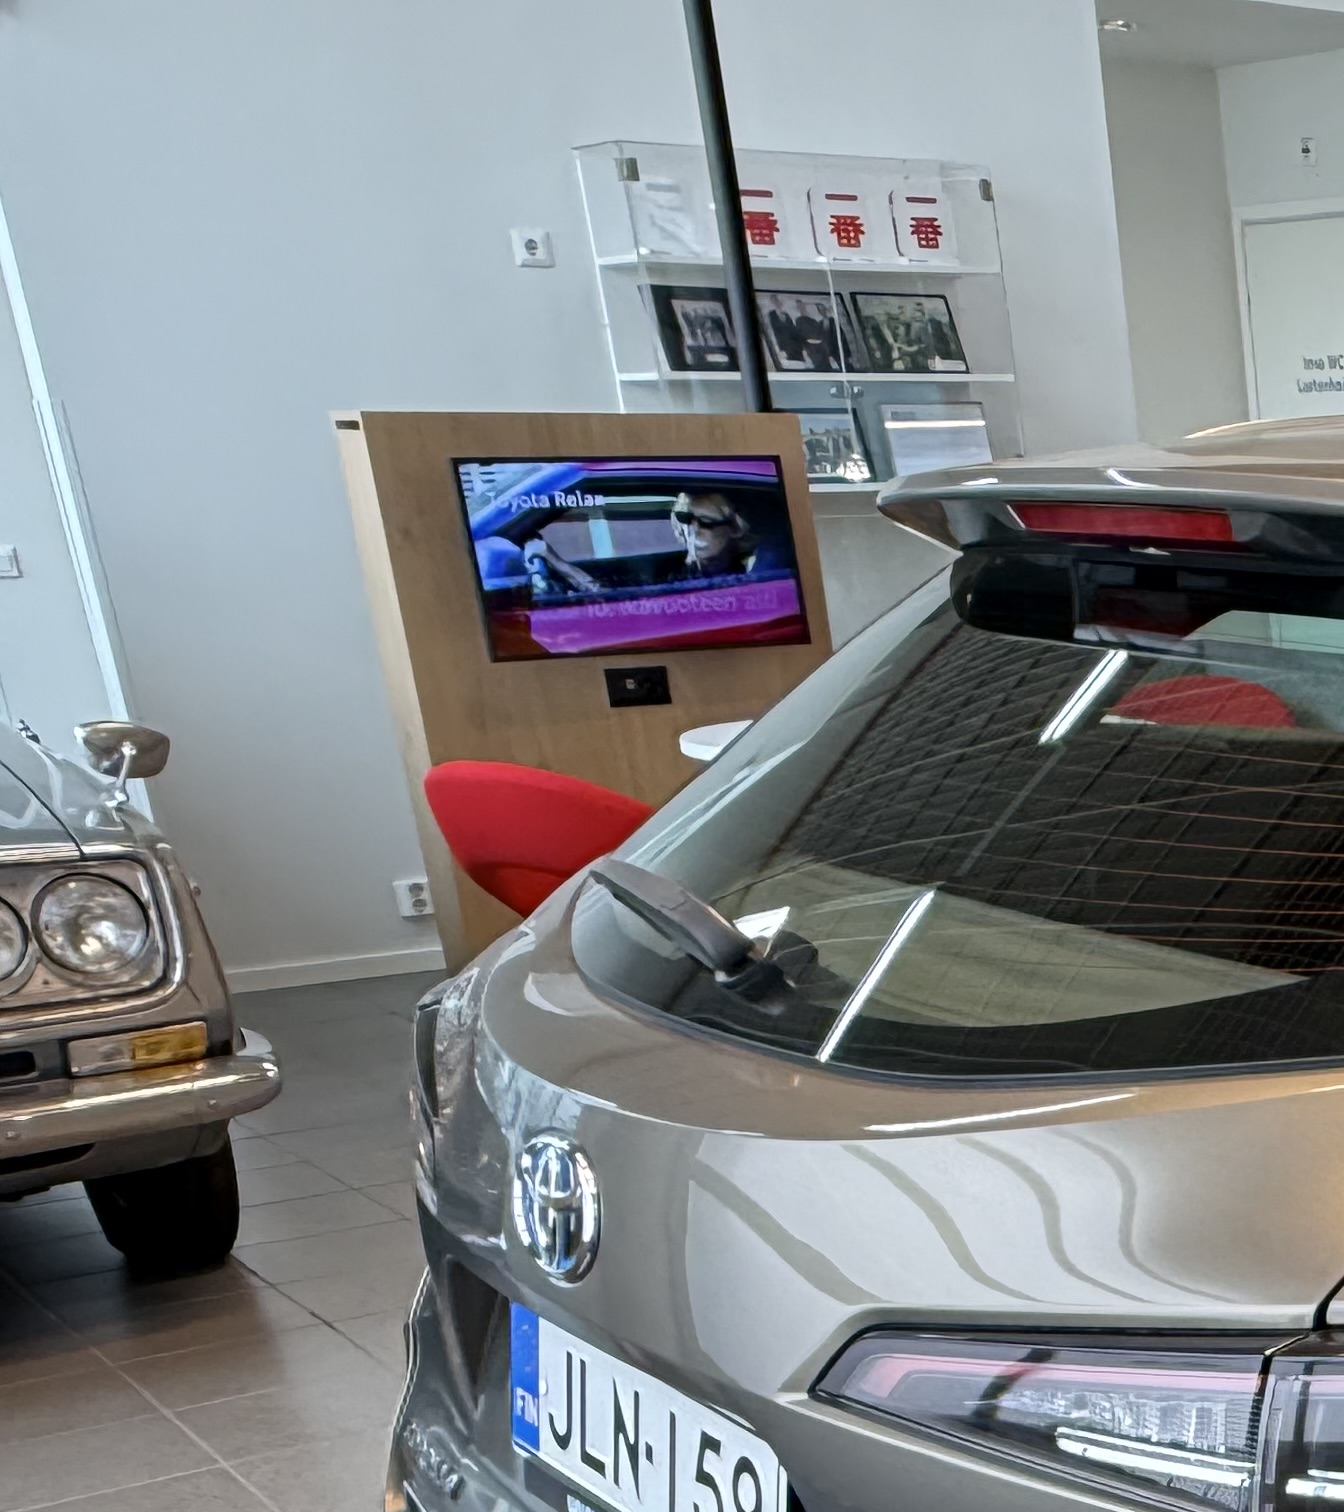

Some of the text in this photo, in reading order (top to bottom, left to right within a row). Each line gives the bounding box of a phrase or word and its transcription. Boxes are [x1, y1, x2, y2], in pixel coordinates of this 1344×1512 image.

[824, 192, 866, 248] 一番
[905, 196, 944, 249] 一番
[484, 491, 550, 513] Toyota
[516, 1386, 538, 1427] FIN
